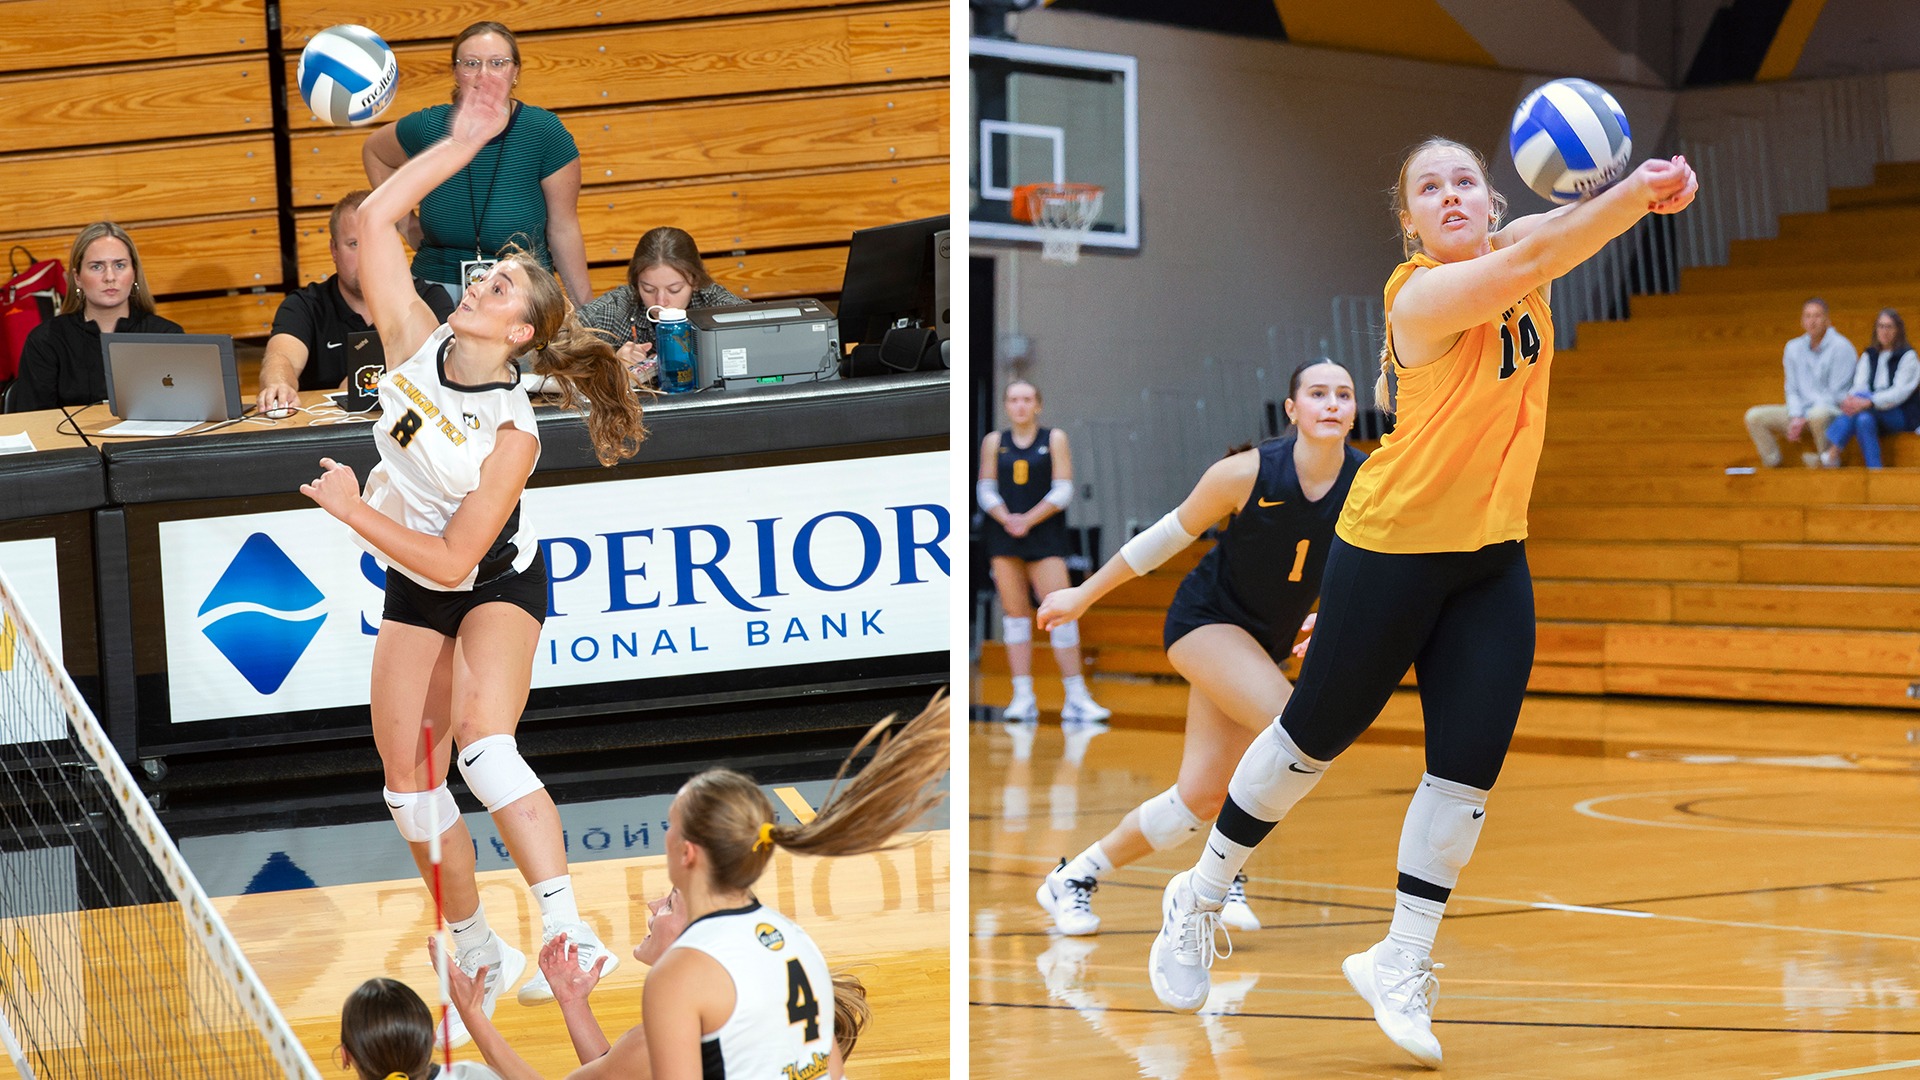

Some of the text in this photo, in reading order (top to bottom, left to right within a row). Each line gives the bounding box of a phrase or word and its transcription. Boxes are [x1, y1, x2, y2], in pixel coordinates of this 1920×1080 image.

[361, 62, 396, 107] molten
[1498, 311, 1541, 380] 14
[391, 372, 467, 447] MICHIGAN TECH
[360, 504, 949, 636] PERIOR
[1287, 538, 1310, 582] 1
[550, 608, 885, 665] IONAL BANK
[786, 957, 820, 1044] 4
